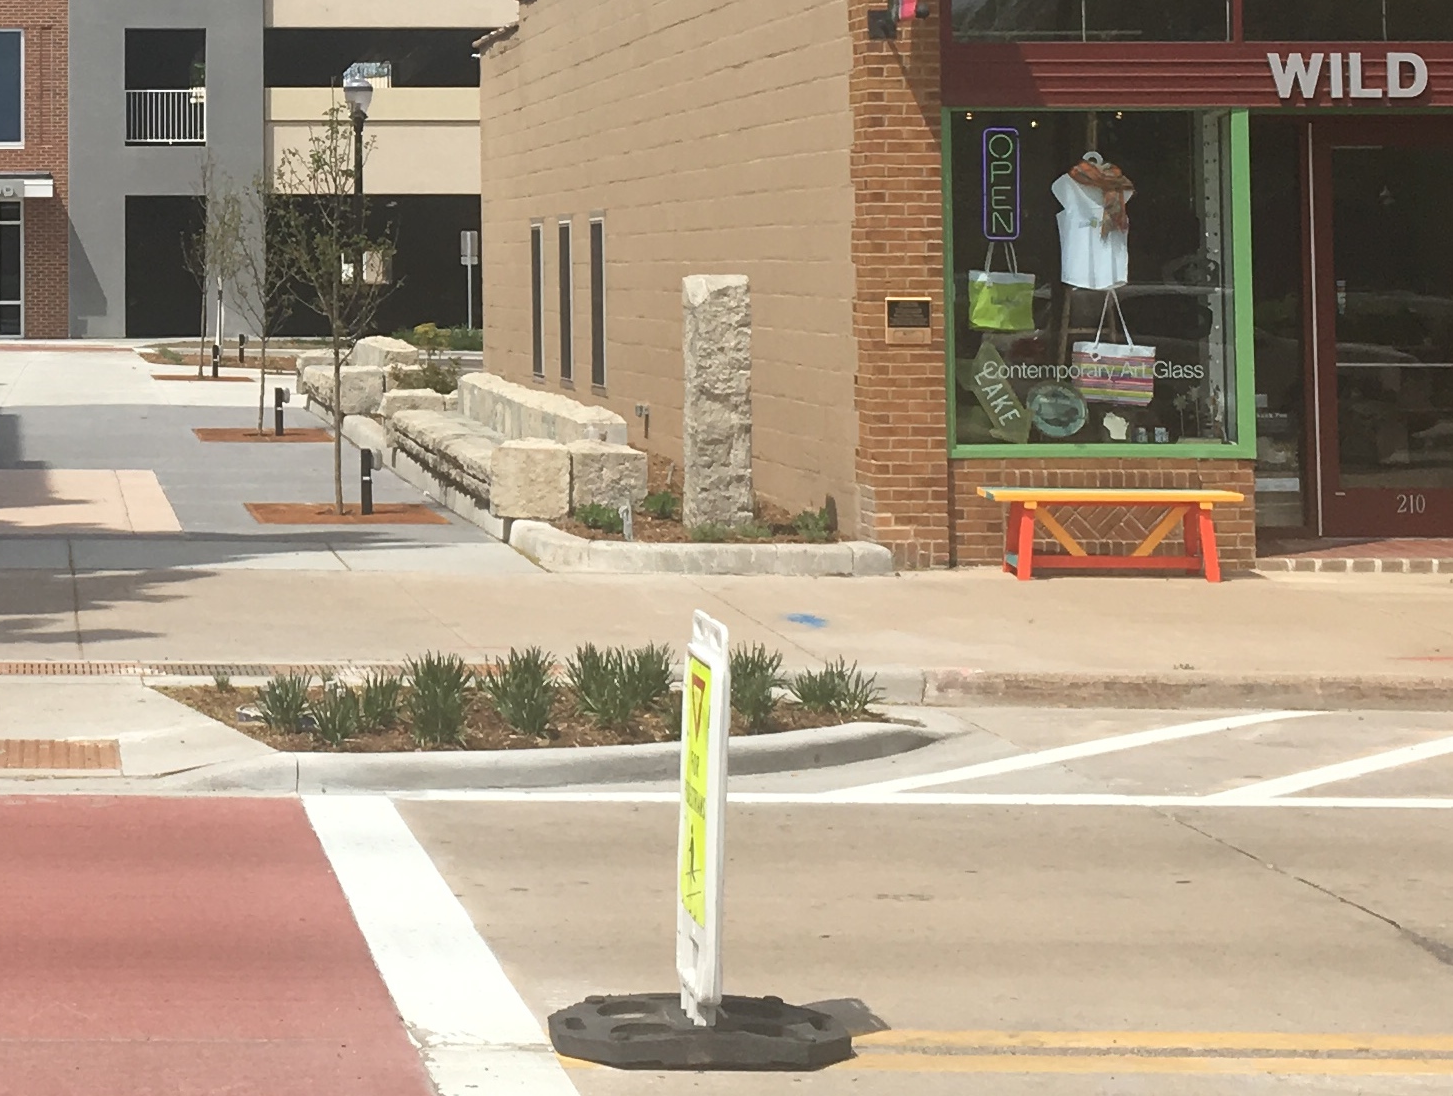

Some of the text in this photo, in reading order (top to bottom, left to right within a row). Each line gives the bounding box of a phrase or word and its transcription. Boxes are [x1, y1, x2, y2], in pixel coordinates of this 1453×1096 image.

[1267, 52, 1429, 99] WILD
[988, 133, 1014, 234] OPEN
[981, 360, 1204, 383] Contemporary Art Glass
[973, 366, 1021, 427] LAKE
[1397, 494, 1426, 514] 210
